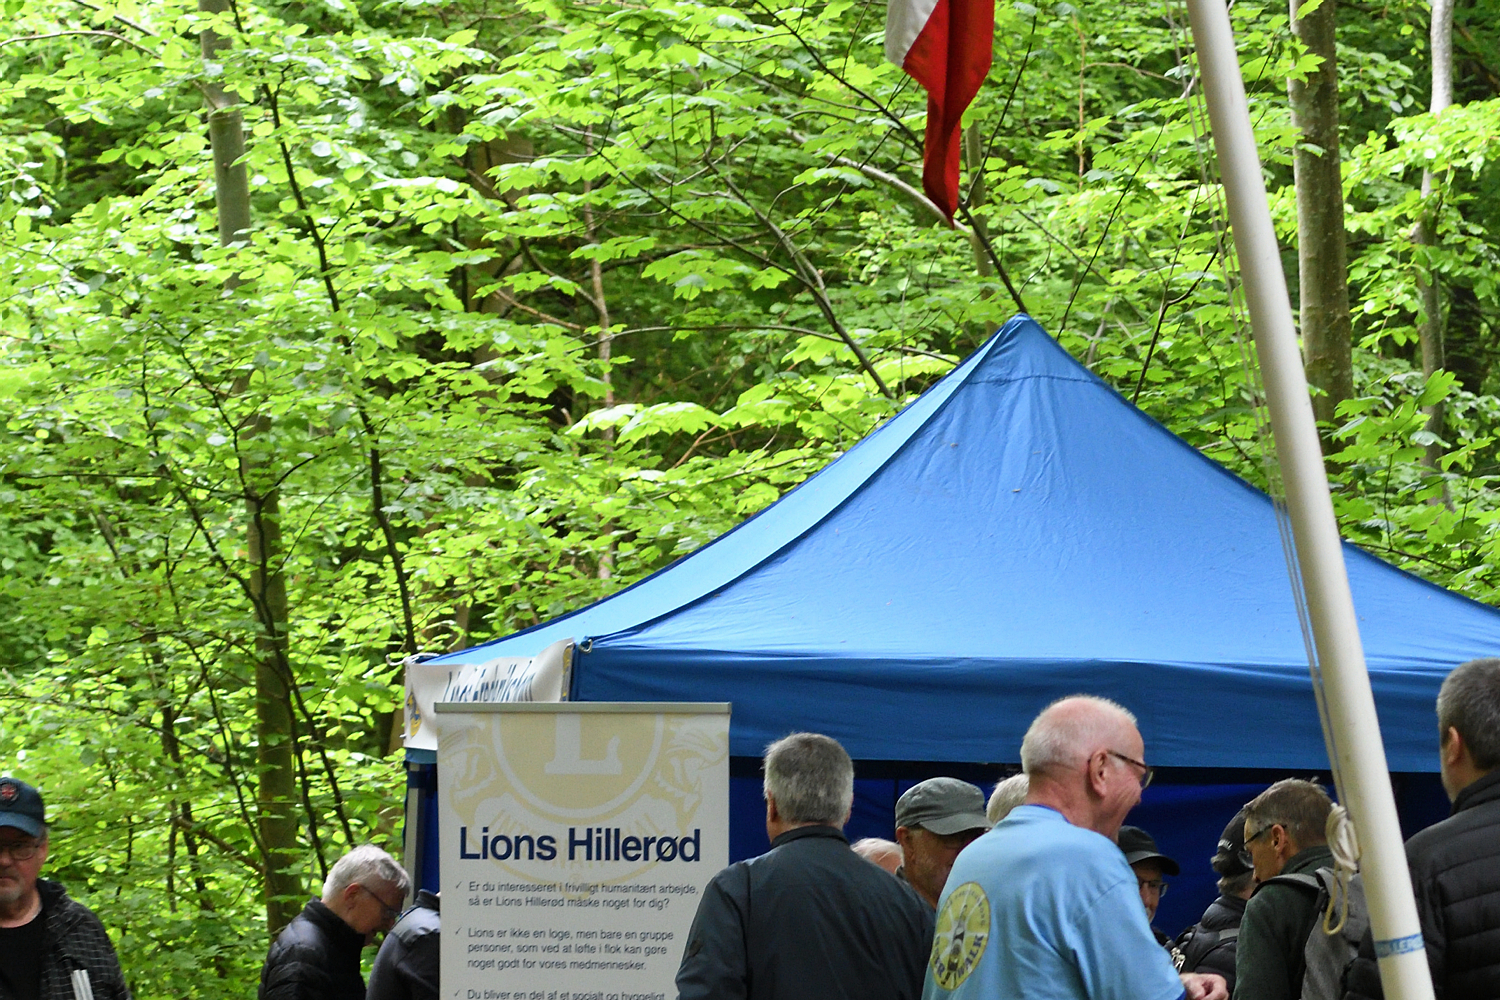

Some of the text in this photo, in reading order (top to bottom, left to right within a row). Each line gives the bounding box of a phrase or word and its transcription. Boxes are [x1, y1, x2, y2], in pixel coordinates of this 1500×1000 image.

[460, 826, 557, 861] Lions
[568, 827, 700, 863] Hillerød
[469, 880, 479, 893] Er
[483, 880, 495, 893] du
[498, 880, 556, 894] interesseret
[565, 881, 598, 897] frivilligt
[601, 882, 656, 895] humanitært
[469, 895, 480, 908] så
[483, 898, 492, 908] er
[496, 895, 522, 908] Lions
[526, 895, 564, 908] Hillerød
[567, 896, 599, 909] måske
[603, 896, 629, 912] noget
[633, 897, 646, 909] for
[468, 926, 494, 939] Lions
[497, 929, 507, 939] er
[510, 926, 530, 939] ikke
[533, 929, 546, 939] en
[576, 930, 597, 940] men
[600, 928, 622, 940] bare
[625, 930, 637, 941] en
[640, 931, 673, 944] gruppe
[517, 945, 538, 955] som
[541, 942, 559, 955] ved
[563, 943, 572, 955] at
[575, 943, 596, 956] løfte
[605, 943, 621, 956] flok
[624, 943, 641, 956] kan
[645, 946, 667, 959] gøre
[468, 957, 495, 973] noget
[498, 957, 519, 973] godt
[523, 958, 536, 970] for
[539, 961, 566, 971] vores
[468, 988, 481, 1000] Du
[484, 988, 510, 1000] bliver
[513, 991, 526, 1000] en
[529, 989, 544, 1000] del
